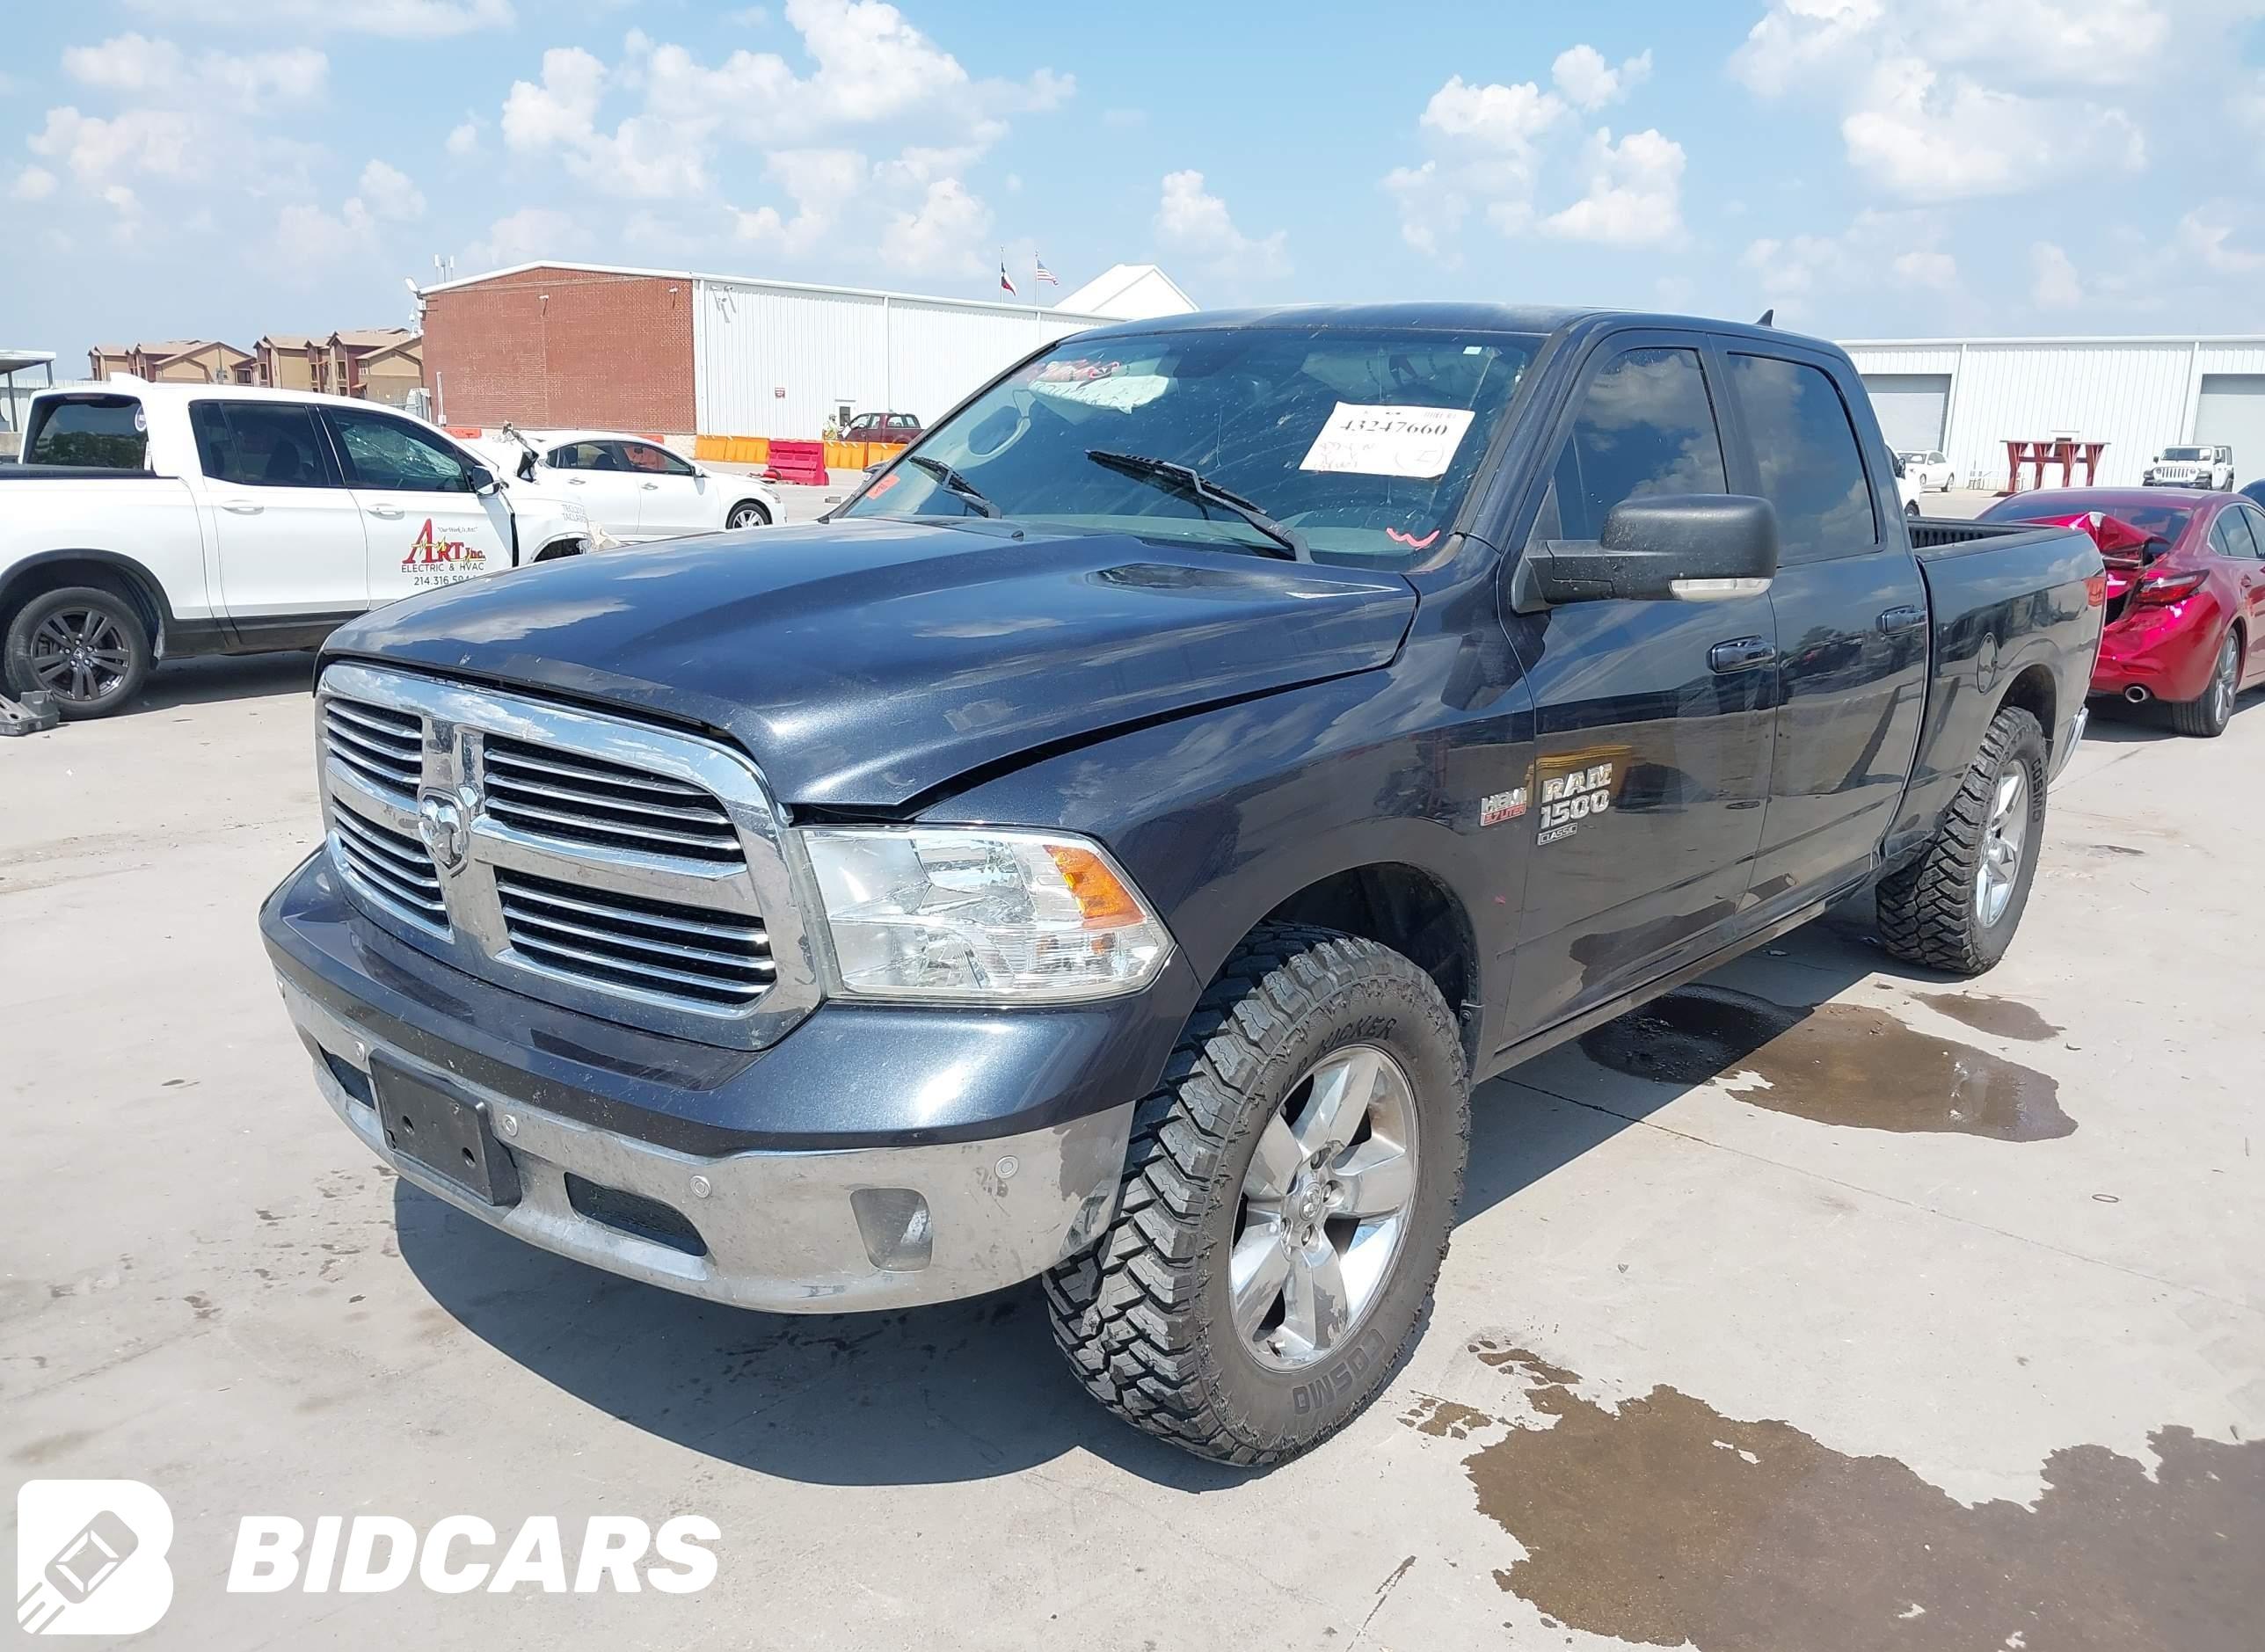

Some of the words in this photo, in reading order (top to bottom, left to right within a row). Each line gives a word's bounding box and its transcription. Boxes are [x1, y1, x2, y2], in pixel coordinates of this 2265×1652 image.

[1339, 418, 1449, 437] 43247660
[401, 564, 445, 573] ELECTRIC
[459, 563, 484, 571] HVAC
[1542, 762, 1613, 804] RAM
[2031, 757, 2043, 824] COSMO
[1500, 804, 1526, 819] LITER
[1540, 789, 1610, 830] 1500
[1540, 824, 1577, 844] CLASSIC
[1292, 1328, 1387, 1415] COSMO
